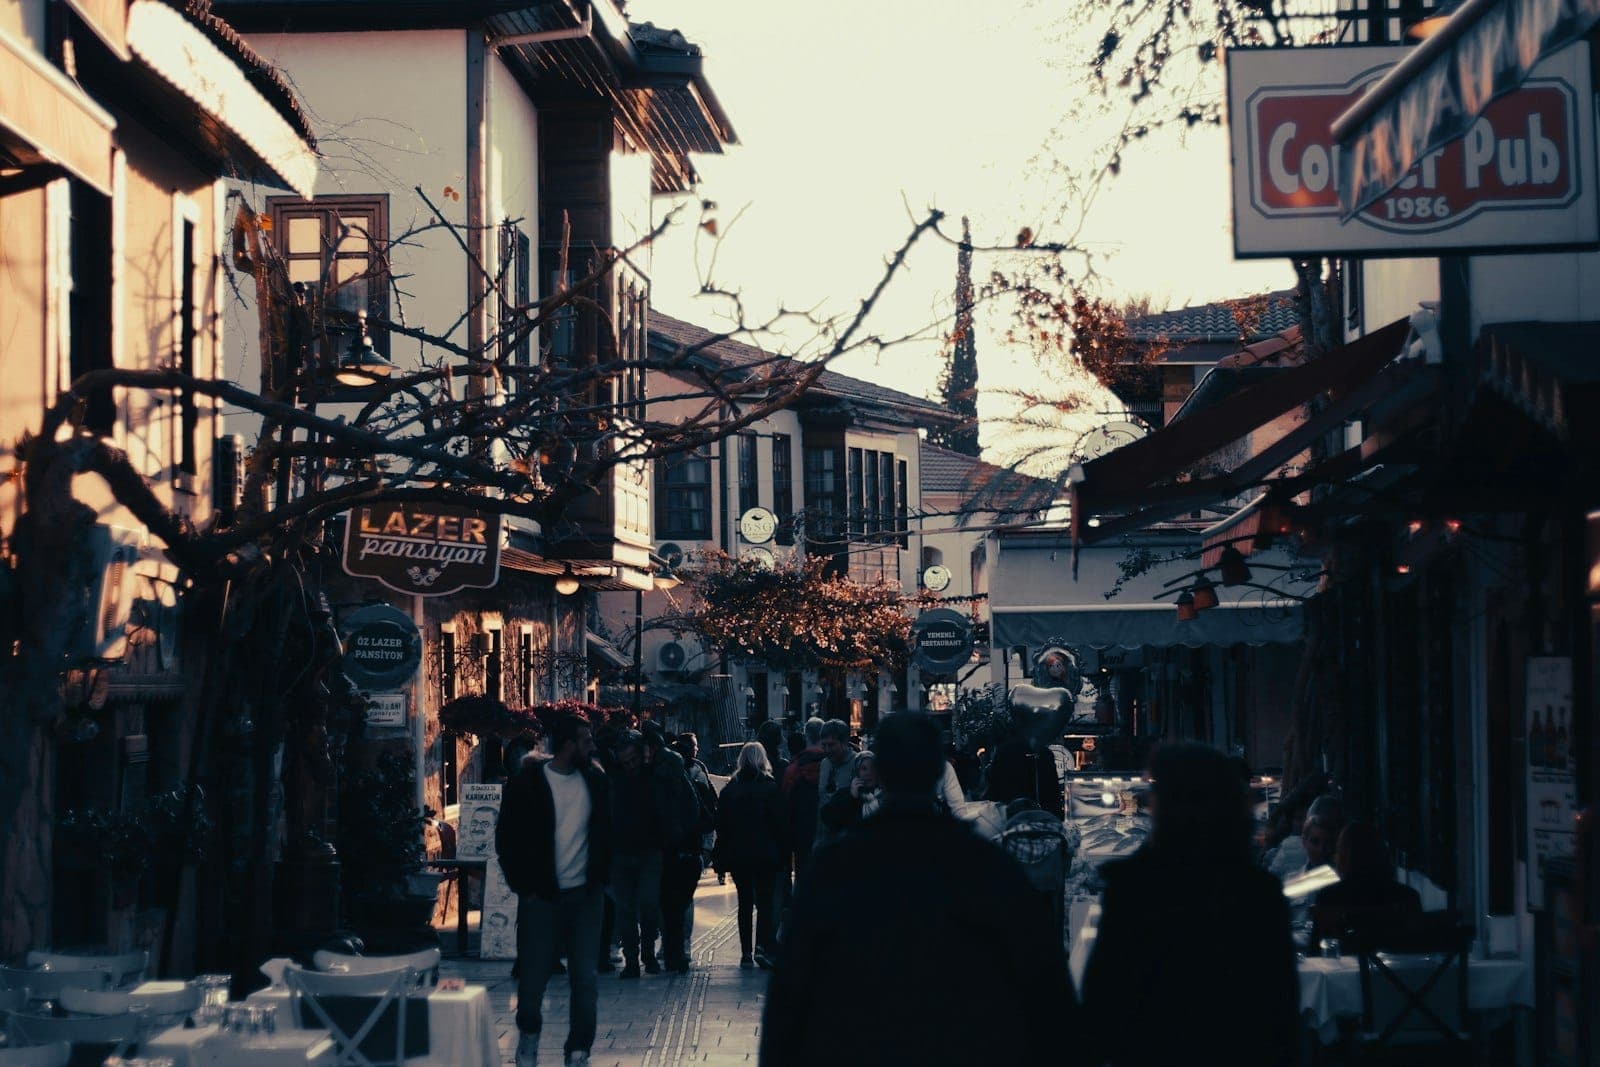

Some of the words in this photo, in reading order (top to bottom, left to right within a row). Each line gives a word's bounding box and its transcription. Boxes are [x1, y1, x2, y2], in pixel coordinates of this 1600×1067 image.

[1464, 111, 1560, 188] Pub
[1384, 196, 1450, 219] 1986
[360, 508, 487, 544] LAZER
[371, 638, 402, 647] LAZER
